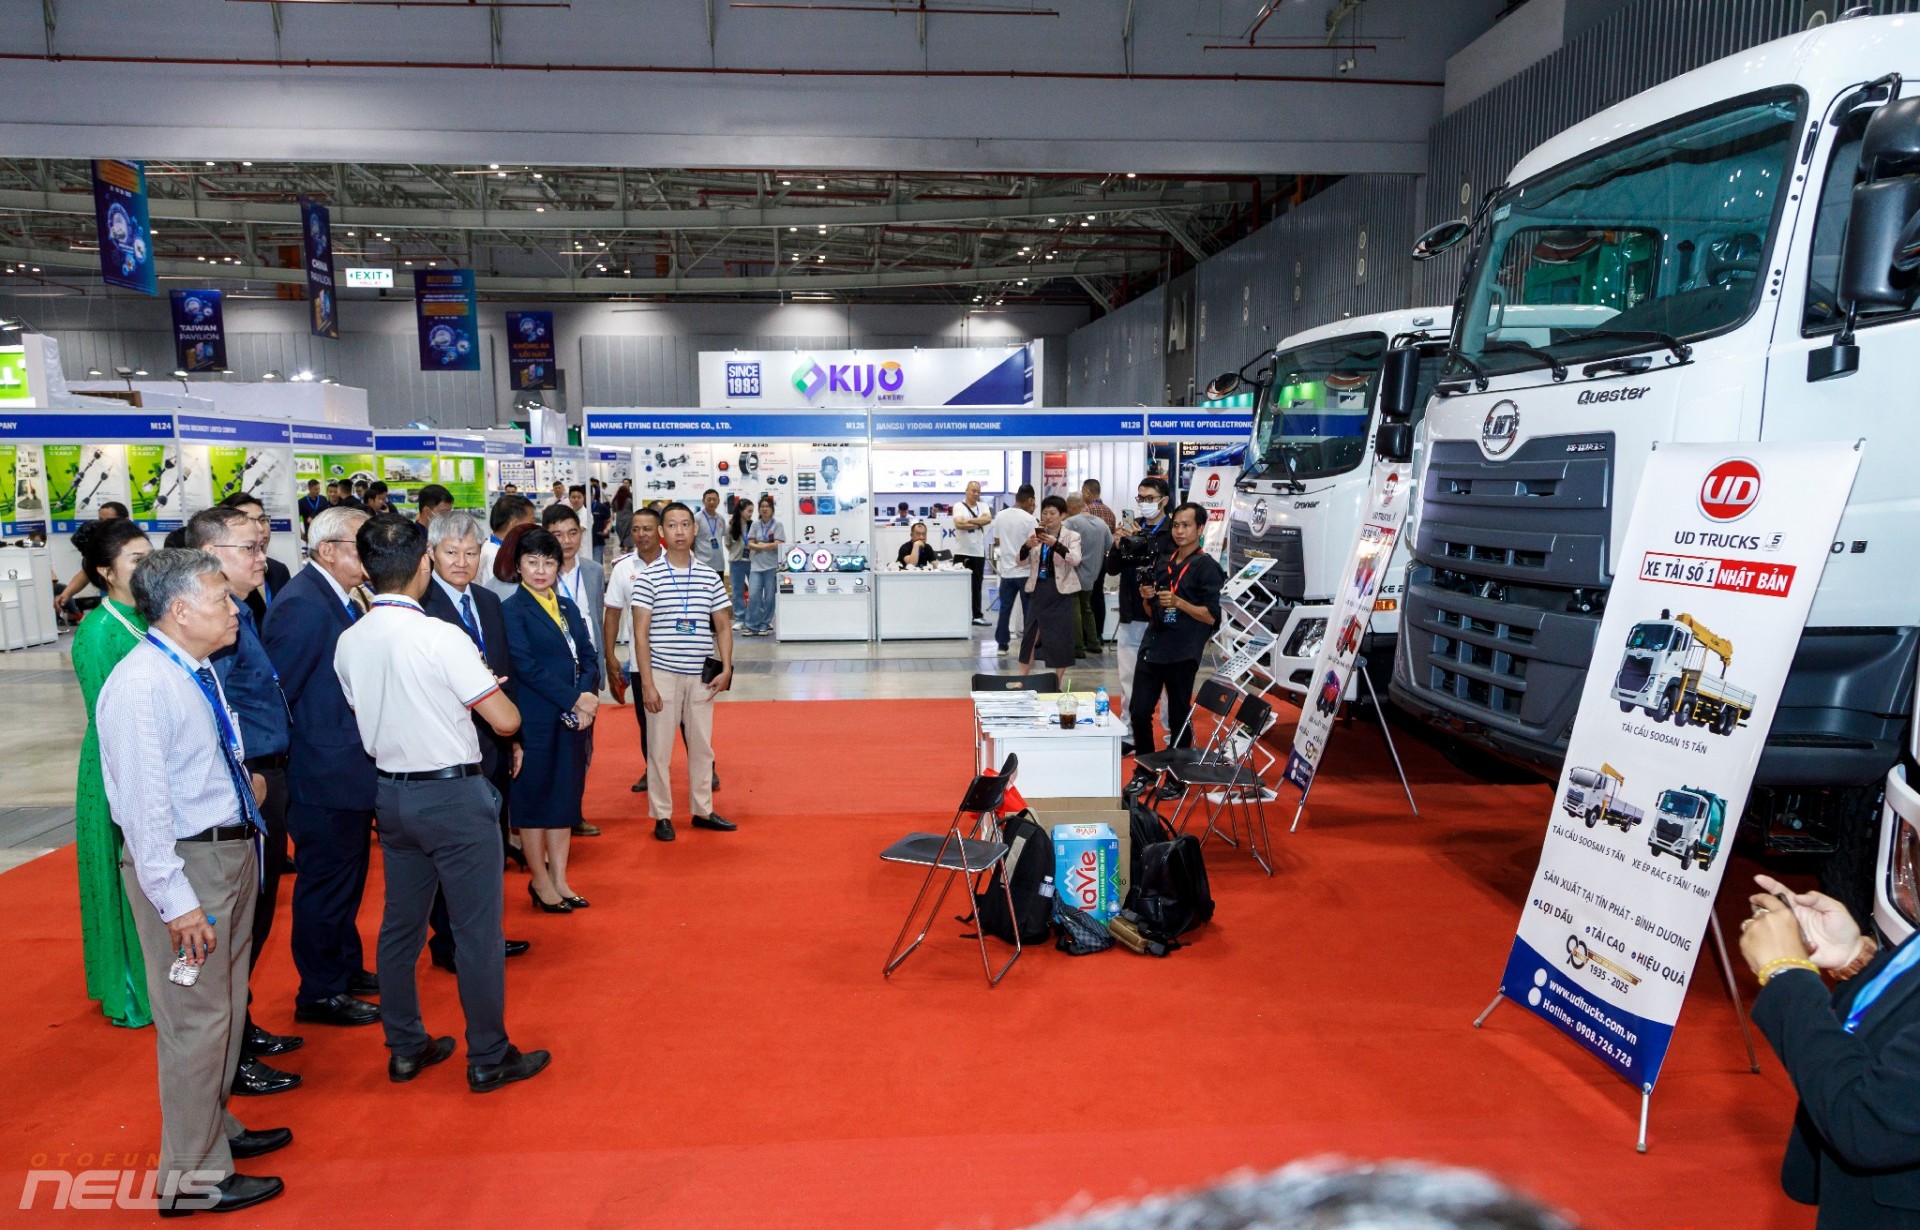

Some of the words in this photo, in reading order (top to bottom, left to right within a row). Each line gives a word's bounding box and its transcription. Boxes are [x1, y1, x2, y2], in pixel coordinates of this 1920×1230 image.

[312, 258, 328, 272] CHINA
[355, 271, 382, 280] EXIT
[310, 271, 332, 286] PAVILION
[179, 332, 220, 340] PAVILION
[728, 365, 758, 378] SINCE
[829, 361, 904, 398] KIJO
[728, 378, 759, 394] 1993
[1578, 386, 1652, 405] Quester
[590, 422, 622, 430] NANYANG
[624, 422, 651, 430] FEIYING
[652, 422, 700, 430] ELECTRONICS
[701, 422, 714, 430] CO.,
[716, 422, 732, 430] LTD.
[876, 422, 905, 430] JIANGSU
[1702, 474, 1760, 504] UD
[1674, 531, 1696, 545] UD
[1698, 532, 1760, 550] TRUCKS
[1644, 560, 1660, 577] XE
[1664, 558, 1685, 580] TẢI
[1686, 560, 1708, 581] SỐ
[1707, 567, 1714, 583] 1
[1717, 568, 1755, 590] NHẬT
[1756, 568, 1789, 592] BẢN
[1621, 722, 1633, 733] TẢI
[1649, 730, 1680, 747] SOOSAN
[1681, 740, 1690, 750] 15
[1691, 740, 1708, 754] TẤN
[1552, 824, 1564, 837] TẢI
[1579, 837, 1605, 854] SOOSAN
[1605, 848, 1611, 856] 5
[1611, 848, 1626, 862] TẤN
[1075, 850, 1097, 912] laVie
[1632, 858, 1642, 870] XE
[1641, 862, 1651, 872] ÉP
[1650, 865, 1667, 880] RÁC
[1666, 874, 1672, 883] 6
[1538, 899, 1554, 914] LỢI
[1543, 870, 1560, 886] SẢN
[1560, 878, 1581, 896] XUẤT
[1583, 888, 1594, 903] TẠI
[1595, 894, 1608, 909] TÍN
[1608, 902, 1631, 920] PHÁT
[1634, 914, 1656, 934] BÌNH
[1656, 926, 1692, 951] DƯƠNG
[1591, 926, 1606, 942] TẢI
[1606, 936, 1626, 953] CAO
[1590, 964, 1607, 981] 1935
[1610, 977, 1629, 994] 2025
[1636, 952, 1661, 972] HIỆU
[1662, 970, 1686, 987] QUẢ
[1549, 980, 1637, 1046] www.udtrucks.com.vn
[1542, 998, 1575, 1028] Hotline:
[1576, 1021, 1632, 1068] 0908.726.728
